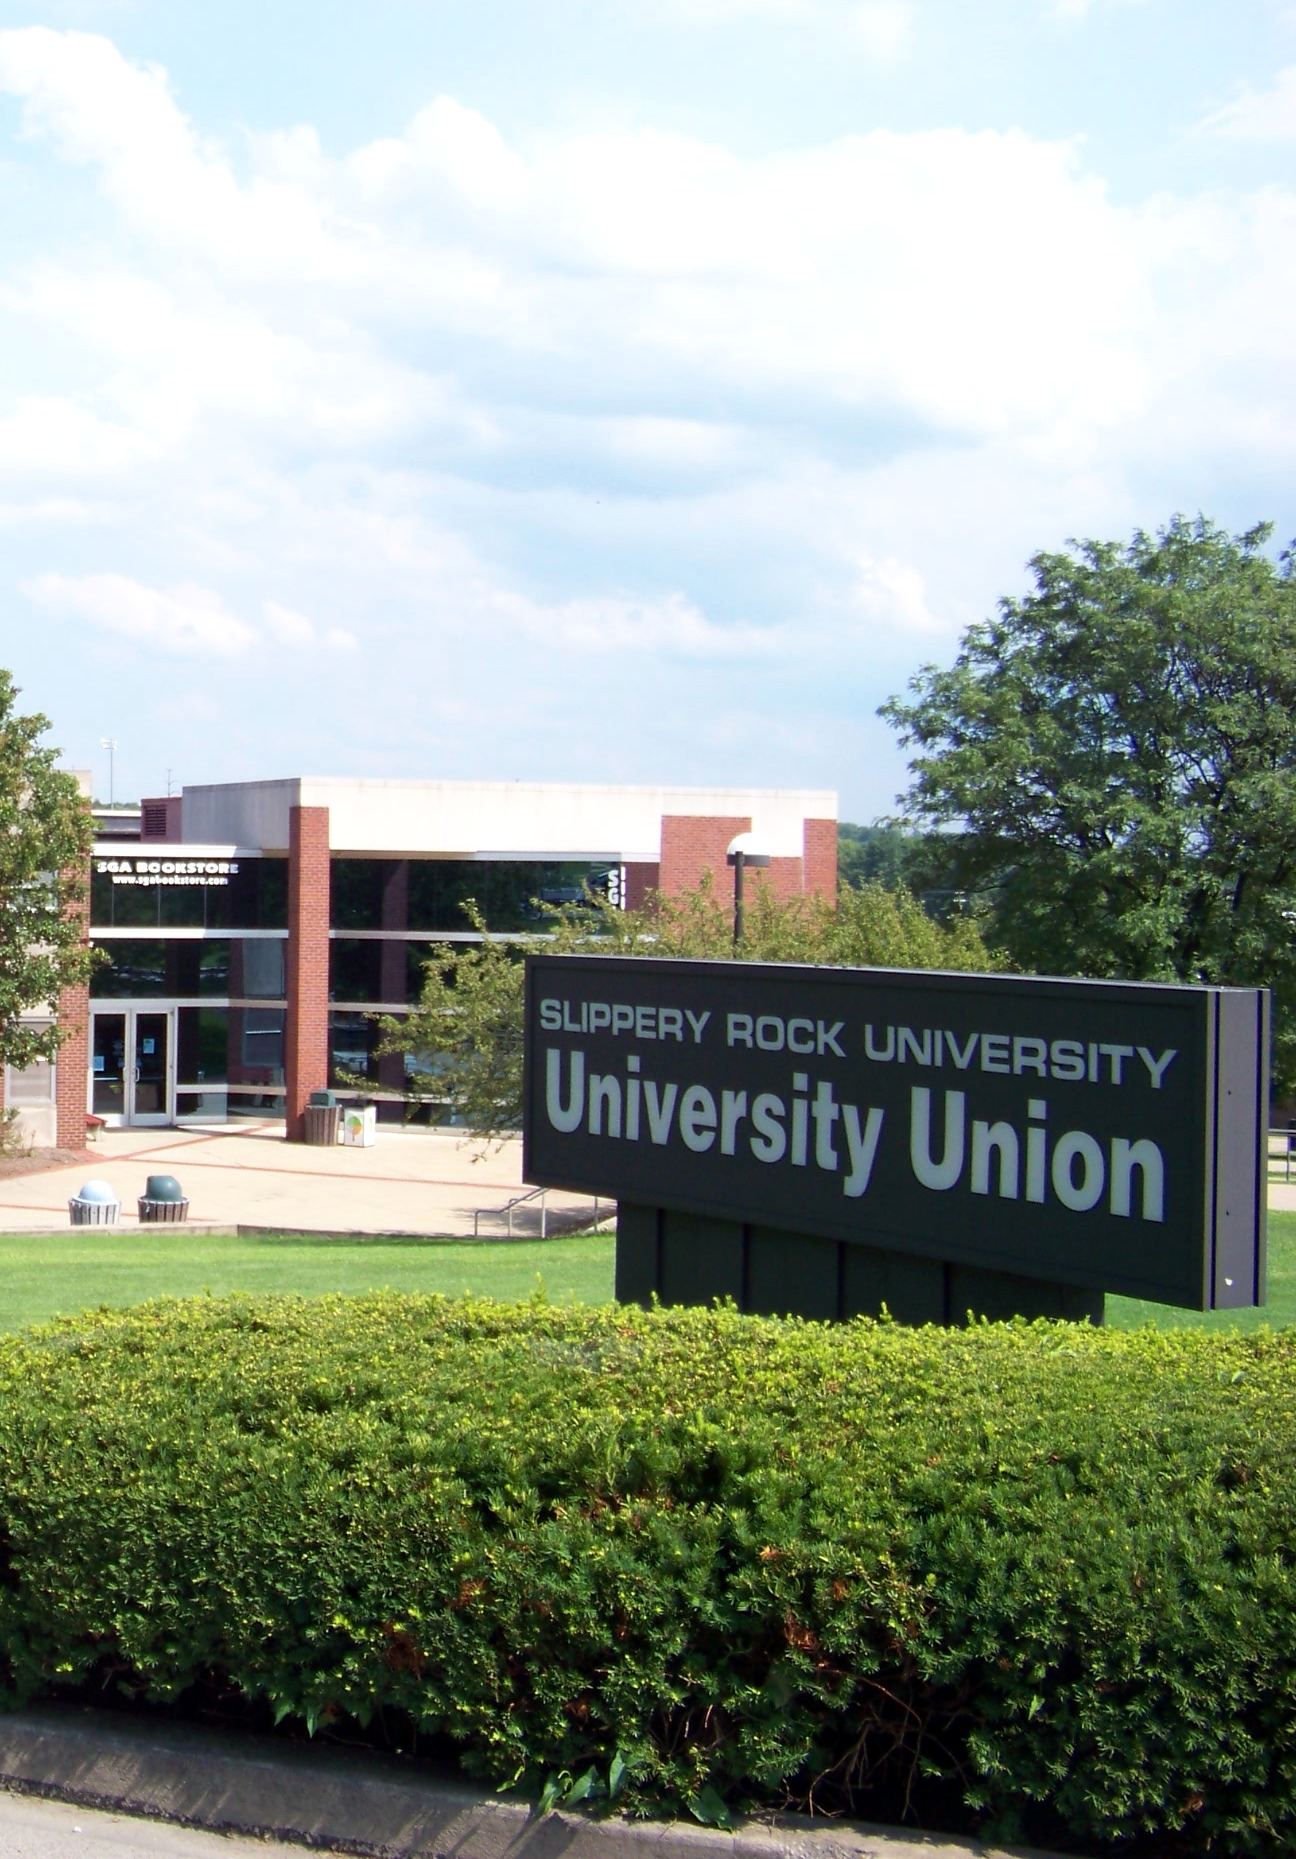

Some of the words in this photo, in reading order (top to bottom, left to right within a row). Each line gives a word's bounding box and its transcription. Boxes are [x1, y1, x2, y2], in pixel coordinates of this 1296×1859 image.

[97, 861, 132, 873] SGA
[136, 862, 239, 874] BOOKSTORE
[112, 875, 228, 886] www.sgabookstore.com
[540, 999, 711, 1043] SLIPPERY
[727, 1013, 846, 1057] ROCK
[865, 1024, 1177, 1089] UNIVERSITY
[546, 1048, 884, 1197] University
[911, 1086, 1163, 1221] Union
